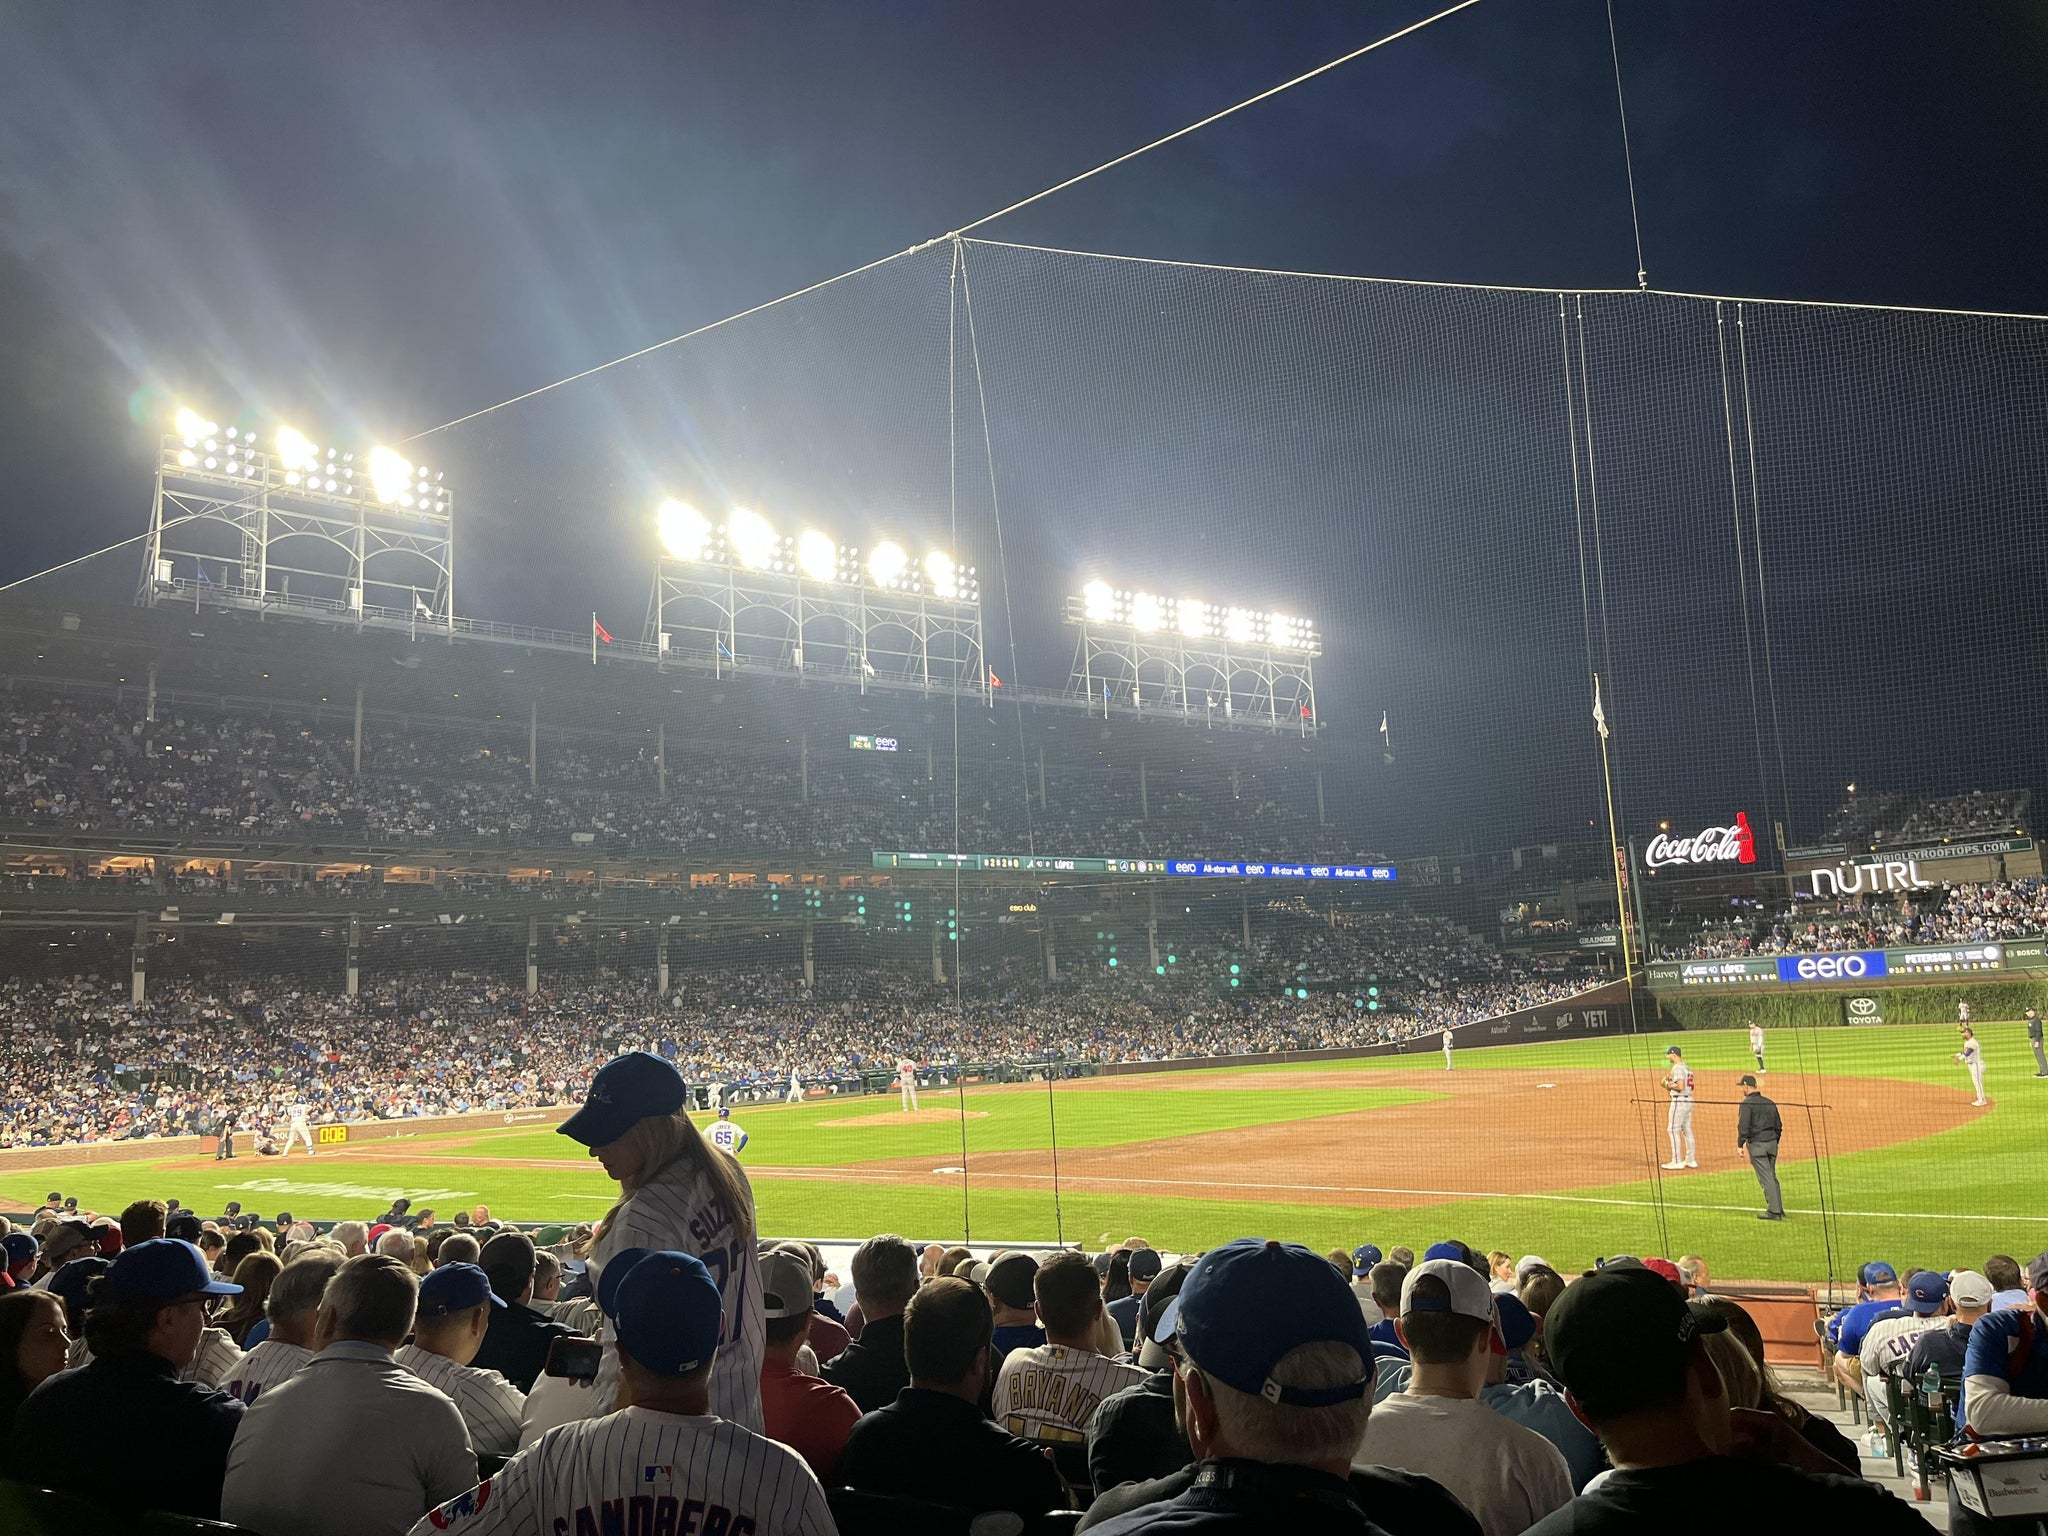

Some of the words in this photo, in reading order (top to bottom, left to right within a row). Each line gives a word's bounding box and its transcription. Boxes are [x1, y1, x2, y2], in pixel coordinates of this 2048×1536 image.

[875, 737, 897, 747] eero
[1645, 825, 1743, 868] Coca-Cola
[1872, 840, 2010, 865] WRIGLEYROOFTOPS.COM
[1002, 858, 1007, 868] 2
[1054, 859, 1074, 870] LÓPEZ
[1176, 862, 1196, 873] eero
[1246, 865, 1266, 875] eero
[1311, 867, 1329, 876] eero
[1372, 869, 1390, 878] eero
[1579, 935, 1616, 945] GRAINGER
[1904, 952, 1952, 964] PETERSON
[1708, 966, 1718, 974] 40
[1720, 963, 1746, 974] LÓPEZ
[1797, 956, 1866, 979] eero
[1648, 970, 1679, 980] Harvey
[1582, 1009, 1608, 1028] YETI
[1848, 1016, 1882, 1025] TOYOTA
[902, 1064, 912, 1074] 40
[292, 1109, 302, 1118] 29
[716, 1131, 732, 1144] 65
[689, 1198, 733, 1250] SUZ
[1009, 1369, 1101, 1430] BRYANT
[1198, 1471, 1216, 1482] CUBS
[1987, 1486, 2039, 1498] Budweiser
